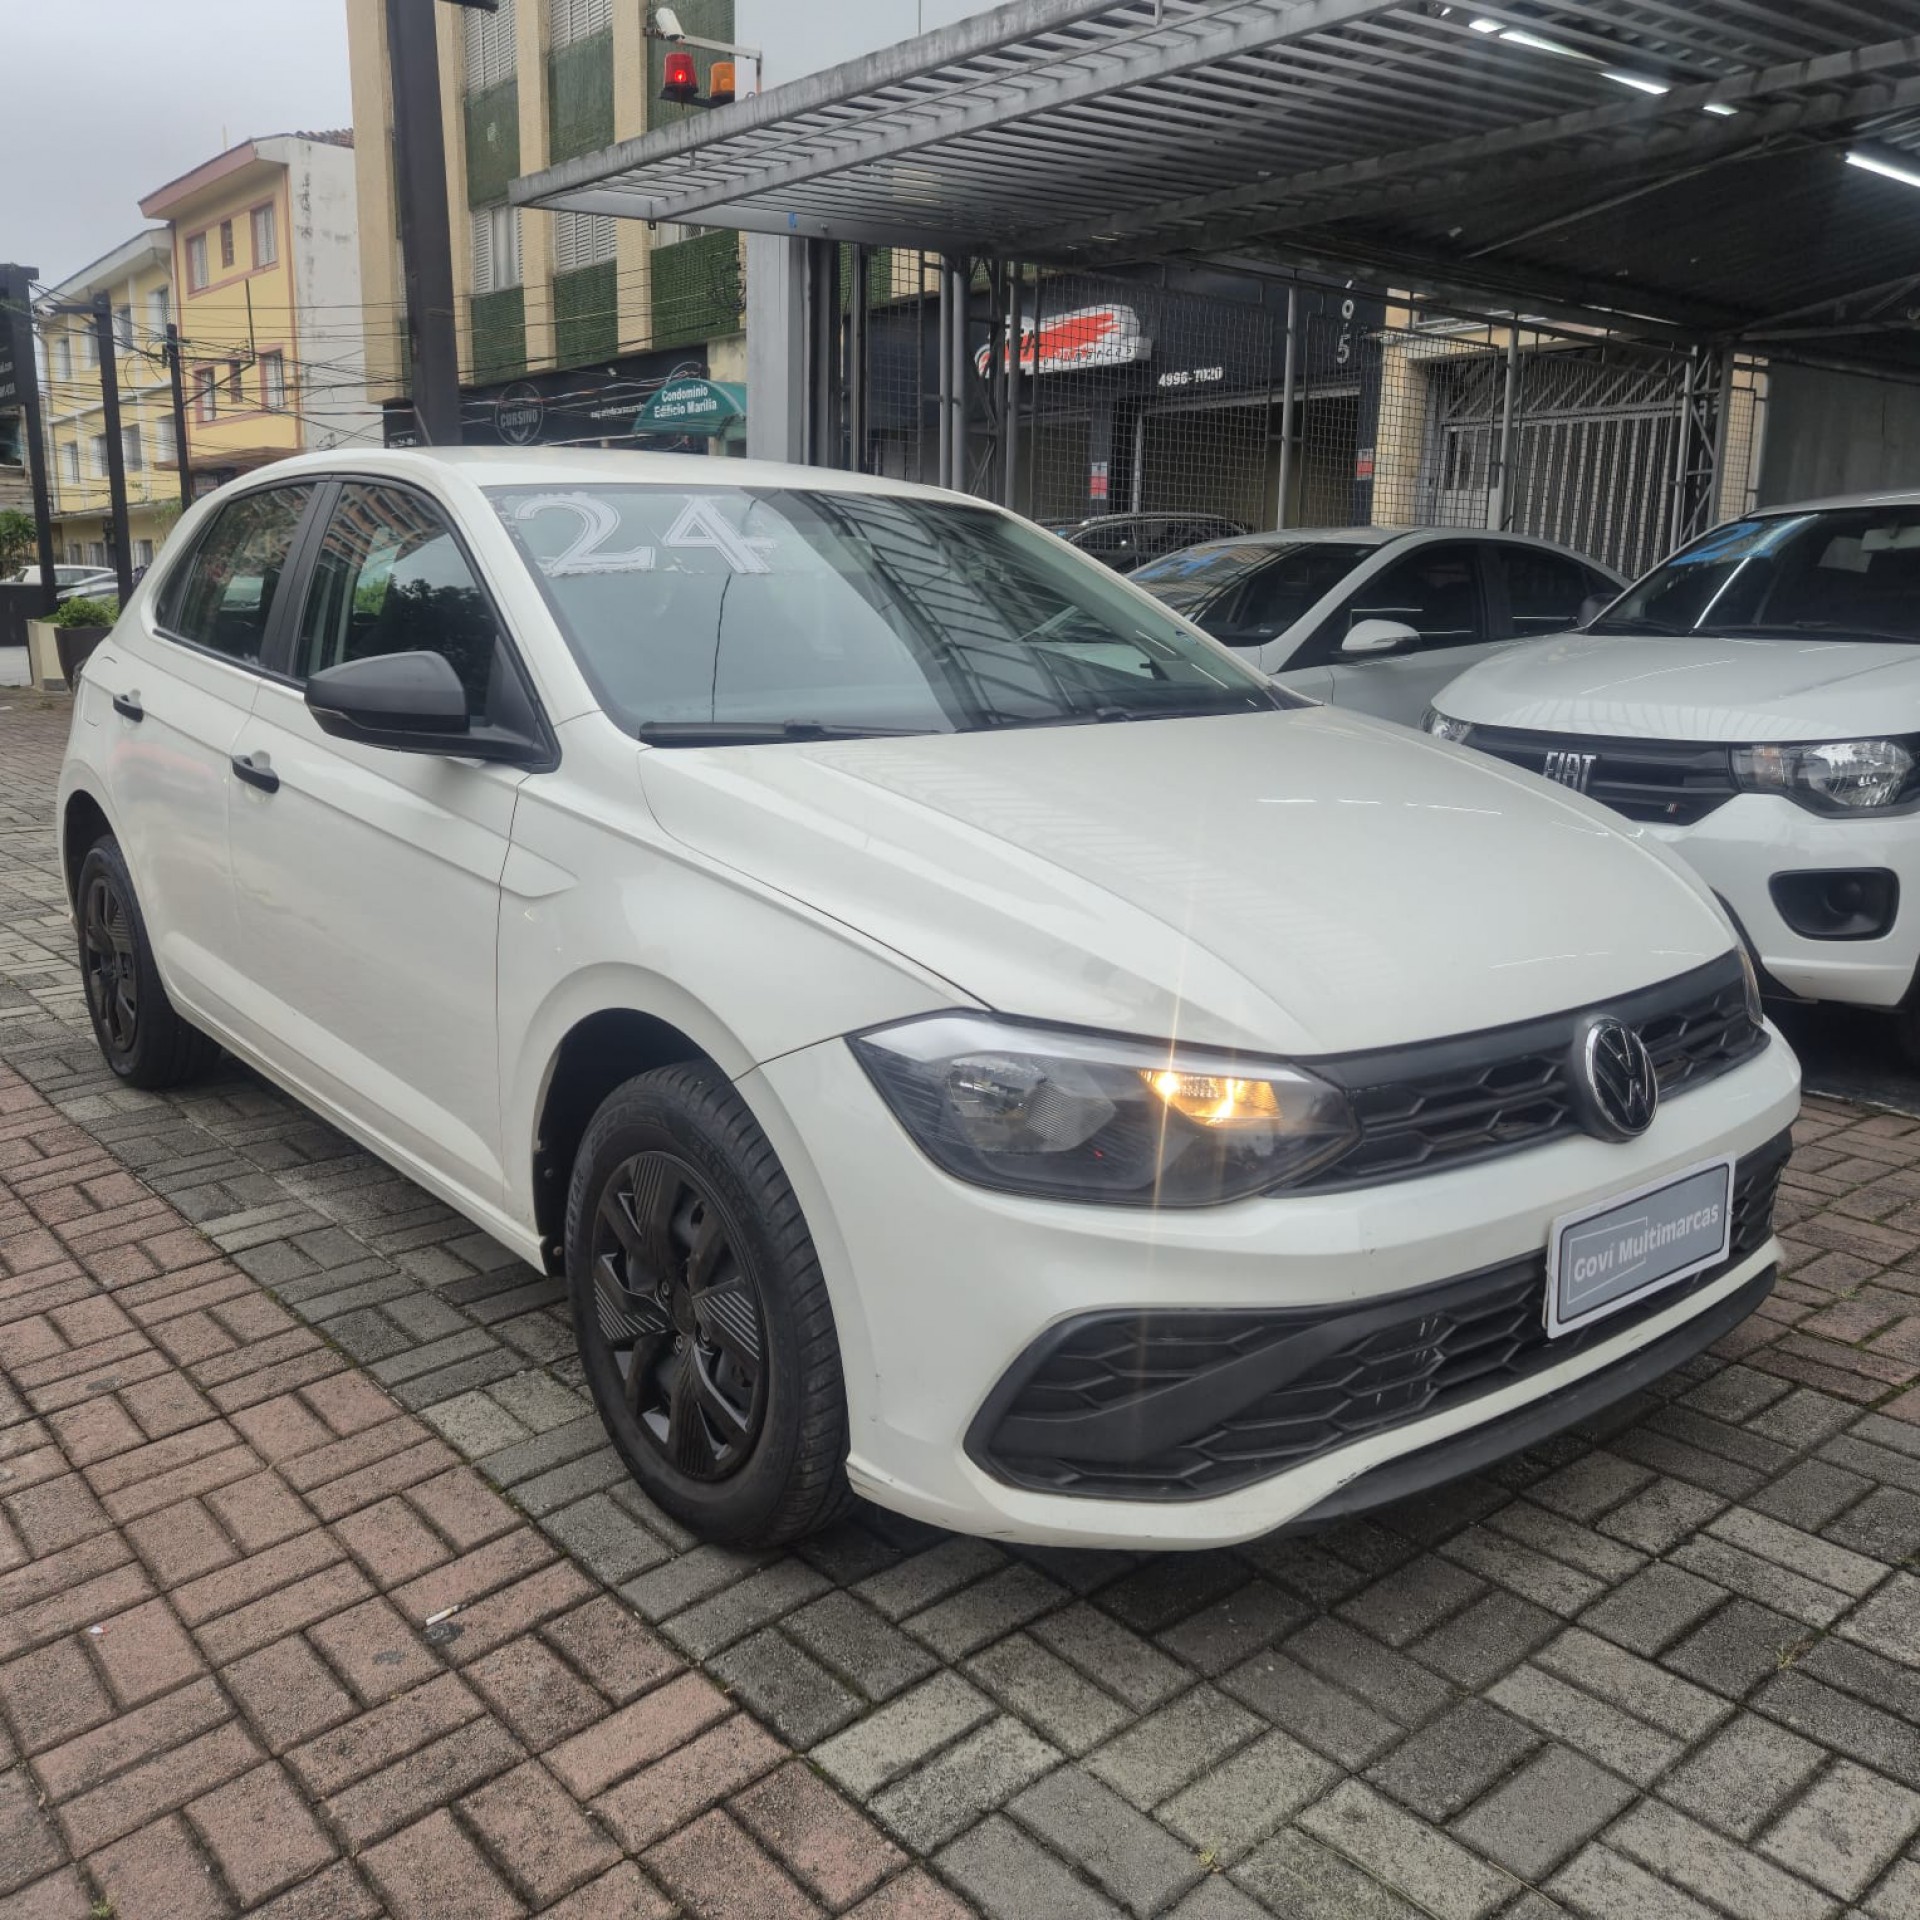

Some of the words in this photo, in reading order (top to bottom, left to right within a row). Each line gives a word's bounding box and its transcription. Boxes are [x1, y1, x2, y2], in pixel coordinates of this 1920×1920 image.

[514, 494, 775, 576] 24
[1543, 751, 1597, 793] FIAT
[1573, 1242, 1614, 1283] Govi
[1619, 1203, 1719, 1264] Multimarcas
